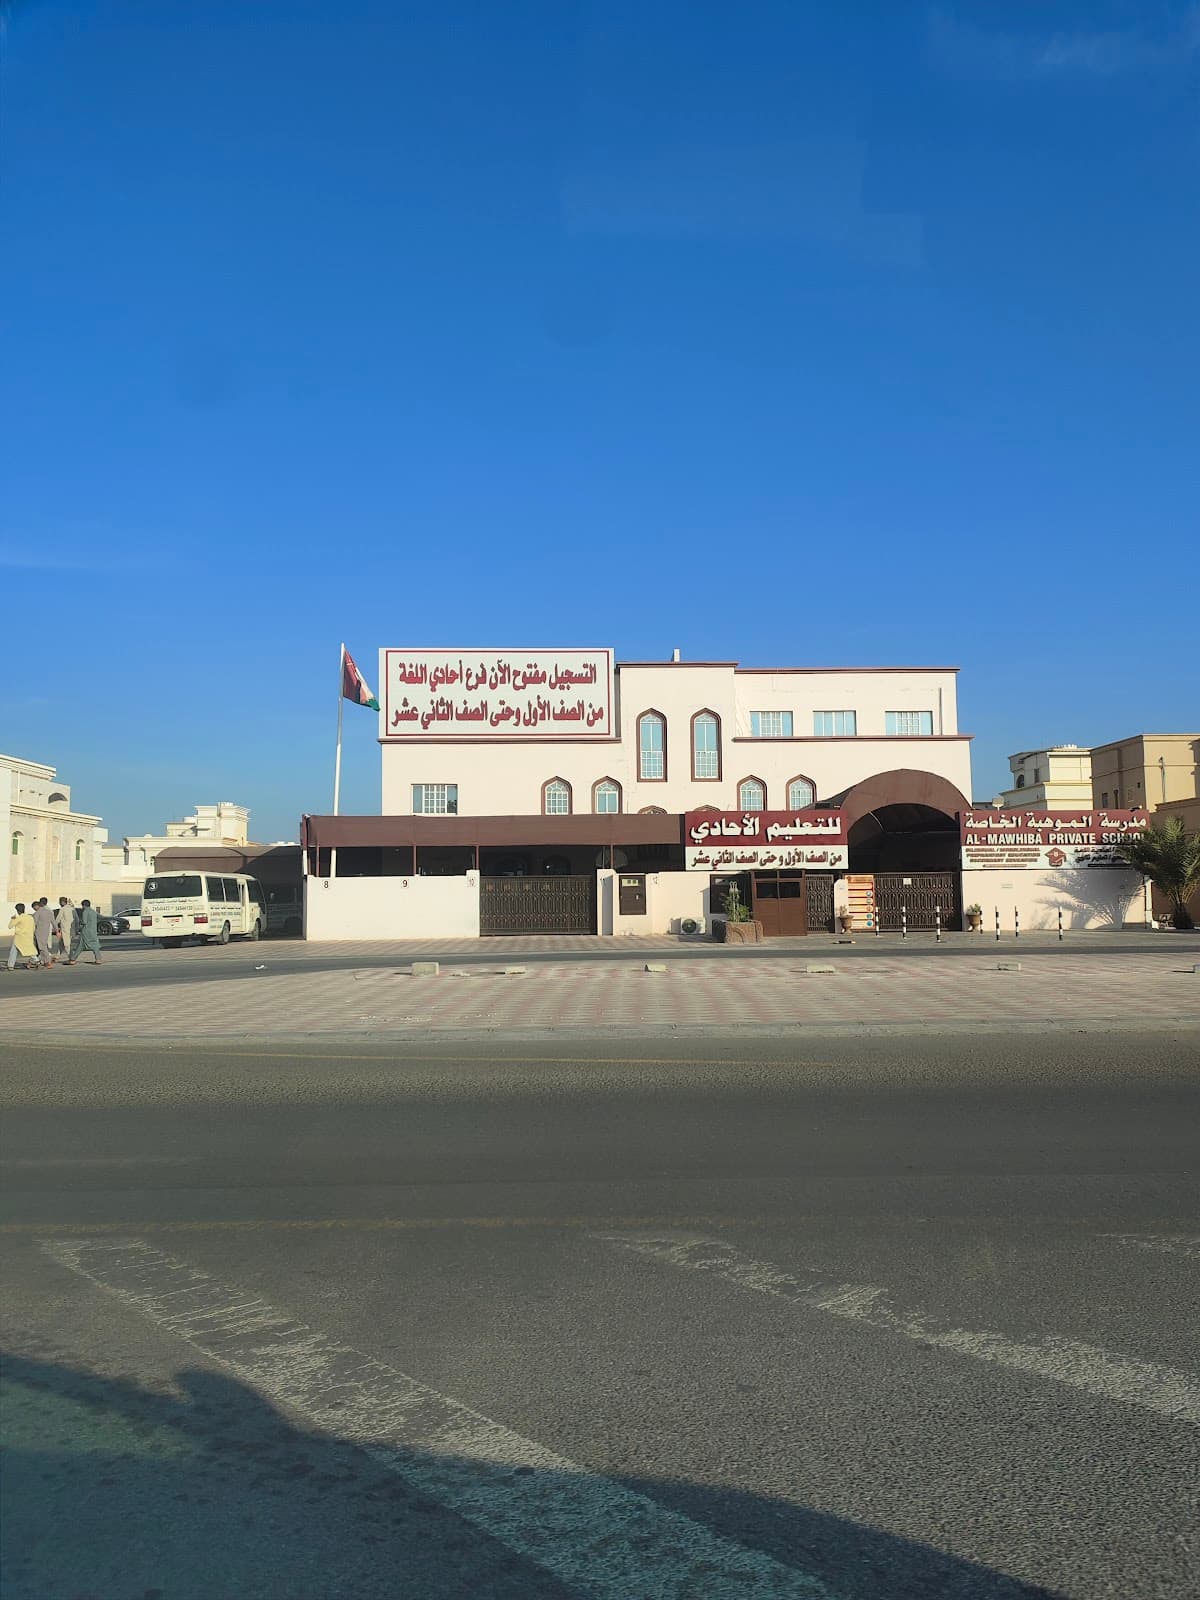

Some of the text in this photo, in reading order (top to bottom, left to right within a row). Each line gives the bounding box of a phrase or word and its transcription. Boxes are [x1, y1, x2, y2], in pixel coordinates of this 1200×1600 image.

[399, 659, 596, 692] التسجيل مفتوح الآن فرع أحادي اللغة
[392, 697, 418, 726] عشر
[421, 697, 453, 729] الثاني
[455, 699, 487, 721] الصف
[523, 695, 550, 726] الأول
[553, 699, 584, 721] الصف
[587, 702, 603, 727] من
[690, 813, 841, 844] للتعليم الأحادي
[964, 812, 1146, 832] مدرسة الموهبة الخاصة
[966, 833, 1042, 844] AL-MAWHIBA
[1049, 833, 1095, 844] PRIVATE
[691, 850, 710, 867] عشر
[711, 850, 734, 869] الثاني
[736, 851, 758, 863] الصف
[785, 848, 804, 866] الأول
[805, 851, 828, 863] الصف
[830, 851, 842, 866] من
[324, 880, 329, 889] 8
[402, 879, 408, 888] 9
